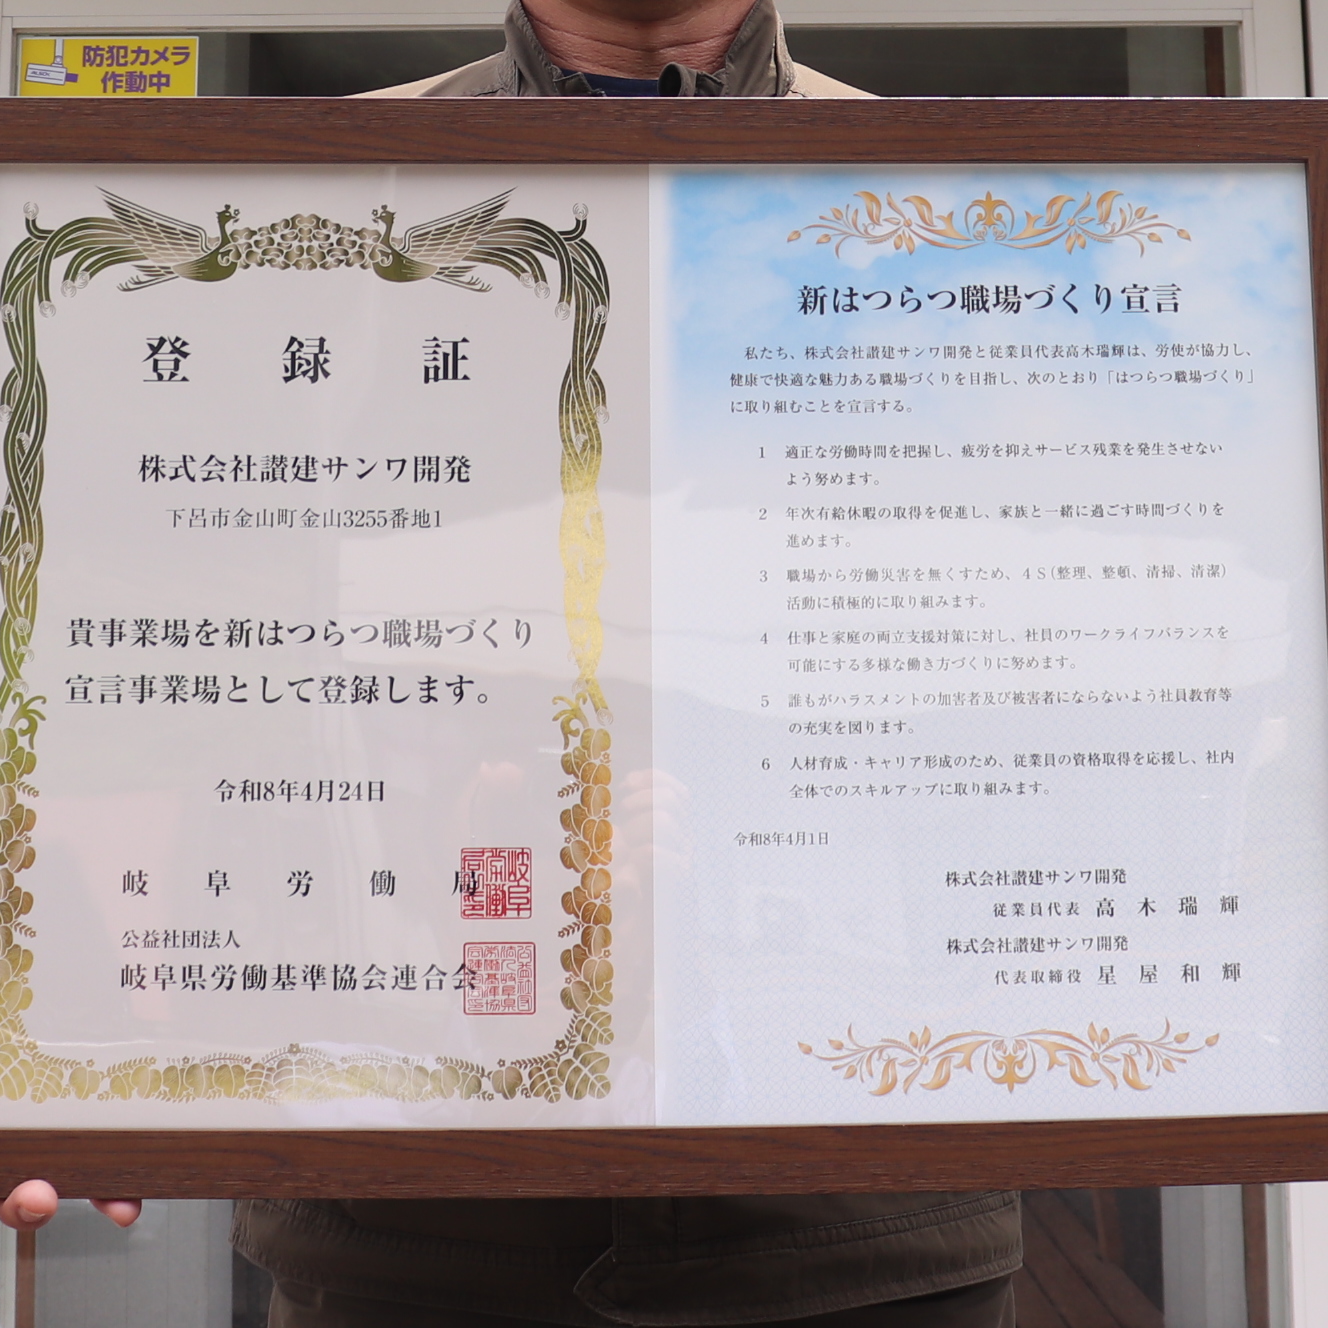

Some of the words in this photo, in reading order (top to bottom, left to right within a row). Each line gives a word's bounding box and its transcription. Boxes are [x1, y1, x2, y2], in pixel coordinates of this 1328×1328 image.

[82, 45, 191, 67] 防犯カメラ
[101, 71, 170, 93] 作動中
[797, 283, 1181, 316] 新はつらつ職場づくり宣言
[142, 335, 471, 385] 登録証
[730, 398, 913, 415] に取り組むことを宣言する。
[758, 447, 766, 459] 1
[138, 454, 472, 484] 株式会社讃建サンワ開発
[786, 472, 880, 487] よう努めます。
[166, 507, 442, 529] 下呂市金山町金山3255番地1
[758, 508, 767, 520] 2
[786, 533, 852, 549] 進めます。
[759, 570, 768, 583] 3
[786, 595, 986, 611] 活動に積極的に取り組みます。
[66, 617, 534, 650] 貴事業場を新はつらつ職場づくり
[760, 633, 769, 645] 4
[787, 656, 1077, 673] 可能にする多様な働き方づくりに努めます。
[65, 674, 490, 705] 宣言事業場として登録します。
[761, 695, 769, 708] 5
[788, 720, 915, 736] の充実を図ります。
[762, 758, 770, 770] 6
[214, 779, 386, 803] 令和8年4月24日
[789, 781, 1050, 799] 全体でのスキルアップに取り組みます。
[734, 831, 829, 847] 令和8年4月1日
[122, 870, 478, 898] 岐阜労働局
[945, 868, 1127, 887] 株式会社讃建サンワ開発
[993, 901, 1080, 918] 従業員代表
[1096, 895, 1240, 918] 高木瑞輝
[121, 929, 241, 949] 公益社団法人
[946, 935, 1129, 955] 株式会社讃建サンワ開発
[120, 963, 478, 991] 岐阜県労働基準協会連合会
[994, 968, 1082, 986] 代表取締役
[1097, 962, 1242, 986] 星屋和輝
